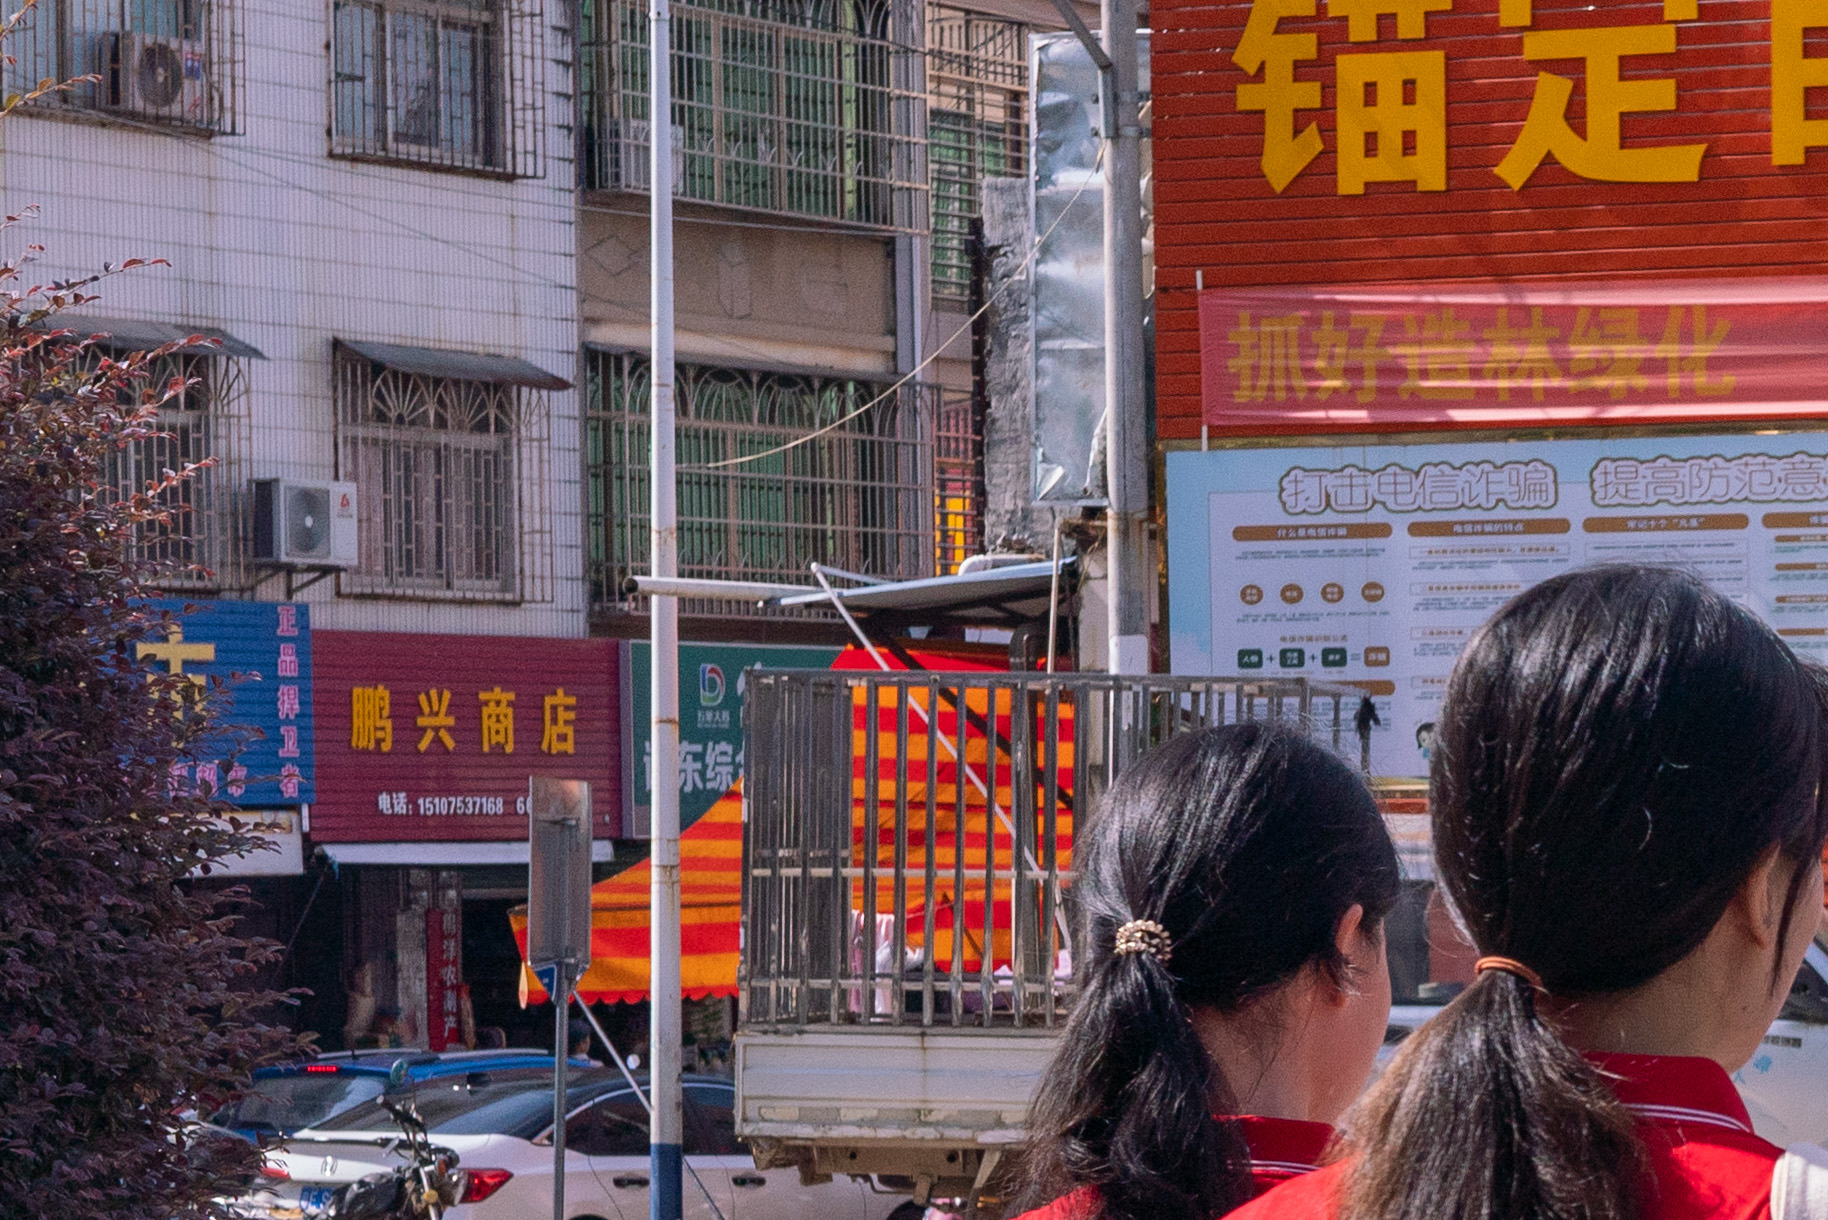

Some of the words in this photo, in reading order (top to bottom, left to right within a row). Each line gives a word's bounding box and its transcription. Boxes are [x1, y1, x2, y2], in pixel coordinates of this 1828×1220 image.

[1228, 305, 1738, 403] 抓好造林绿化
[1281, 461, 1555, 513] 打击电信诈骗
[351, 684, 577, 756] 鹏兴商店
